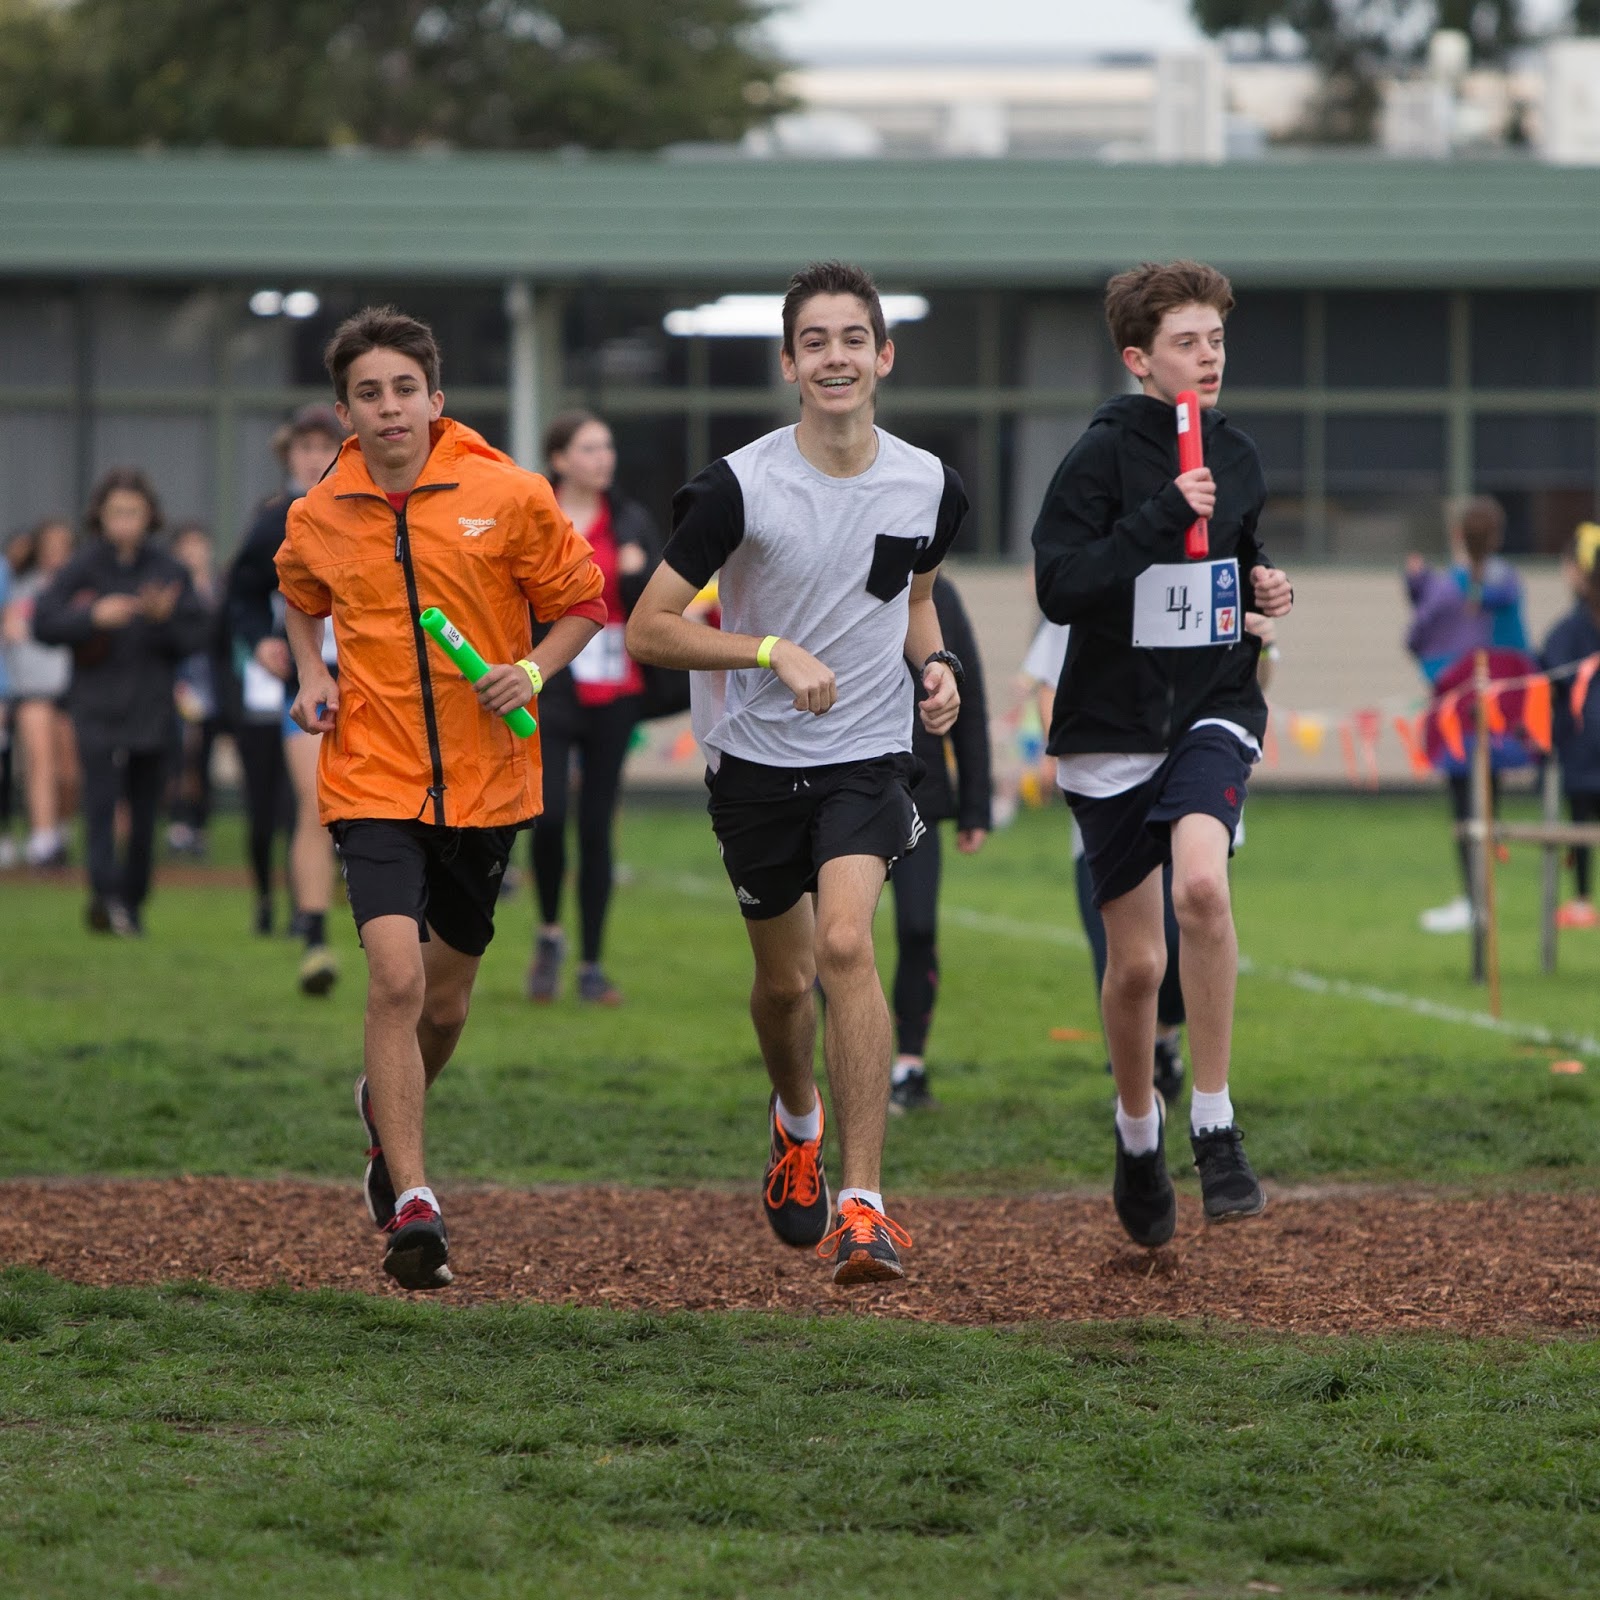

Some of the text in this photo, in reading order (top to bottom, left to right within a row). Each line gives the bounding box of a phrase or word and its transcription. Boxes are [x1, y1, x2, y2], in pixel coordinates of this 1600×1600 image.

[458, 517, 497, 526] Reebok
[1166, 586, 1204, 631] 4 F
